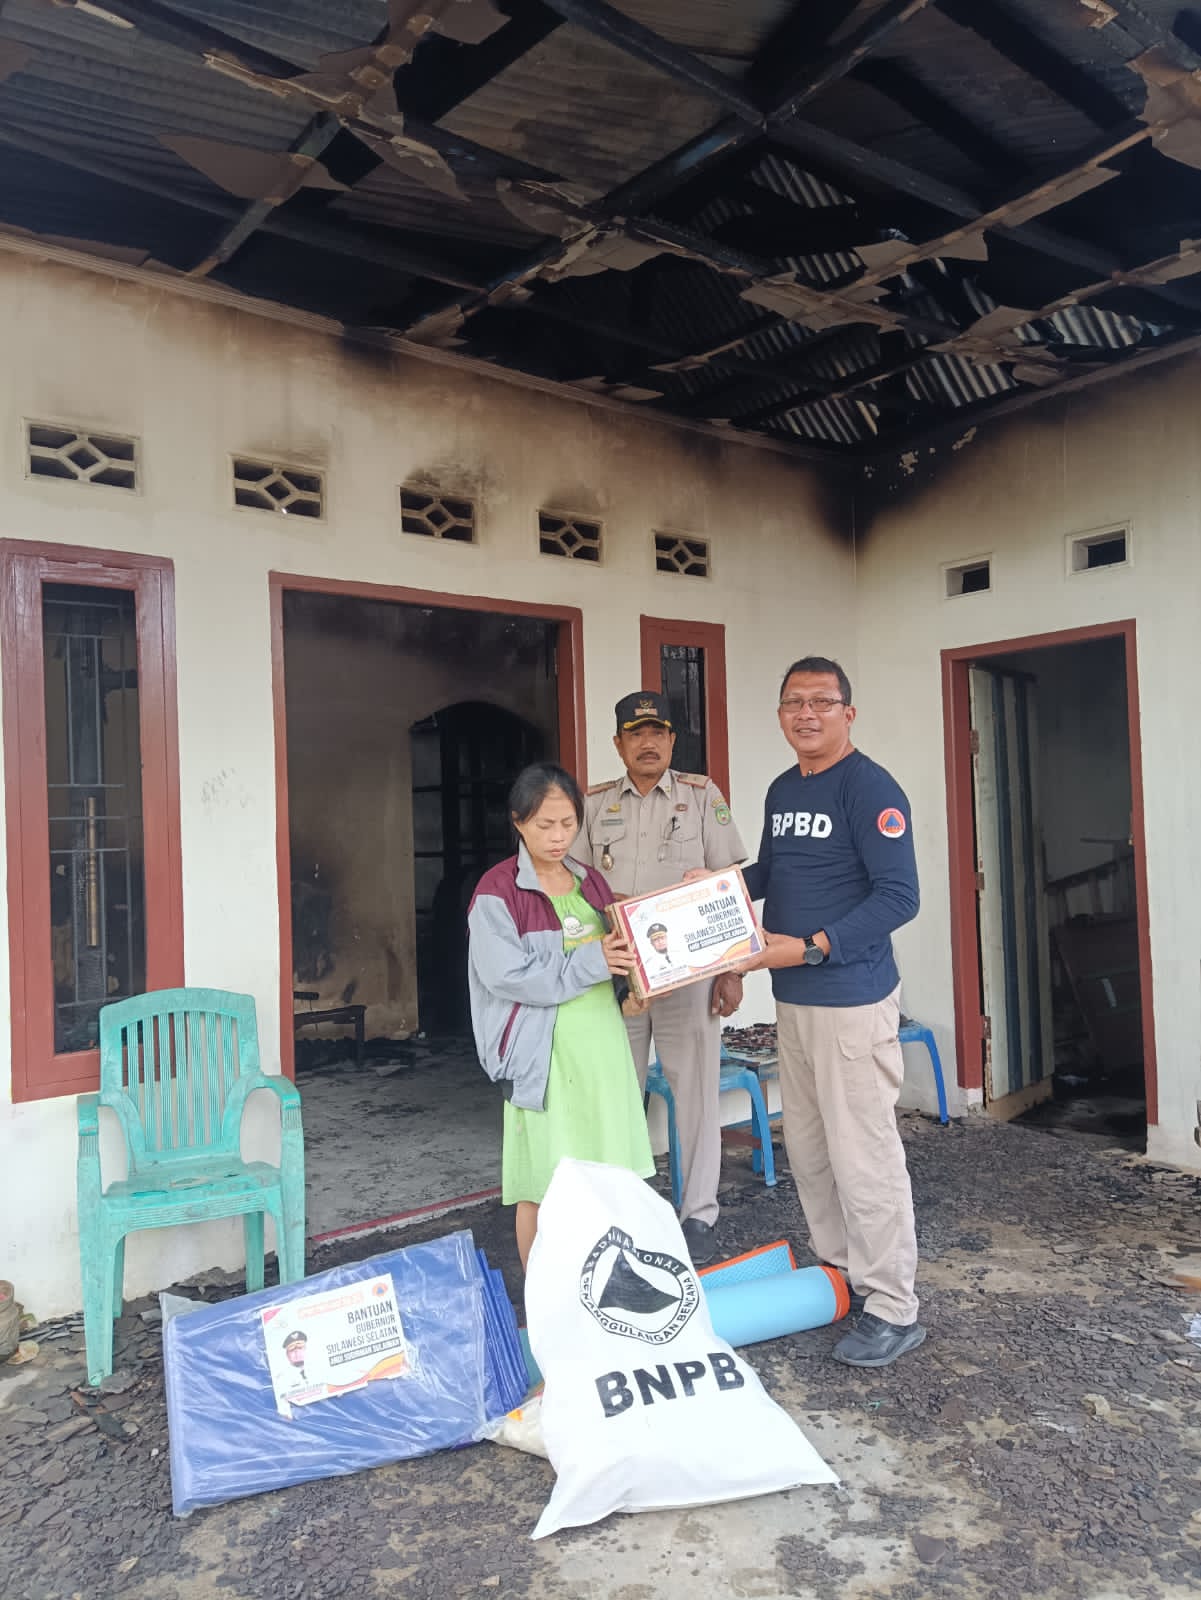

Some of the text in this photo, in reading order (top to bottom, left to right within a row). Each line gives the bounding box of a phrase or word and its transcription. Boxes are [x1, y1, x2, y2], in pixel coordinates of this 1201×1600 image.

[772, 812, 832, 839] BPBD
[698, 895, 737, 916] BANTUAN
[706, 906, 741, 924] GUBERNUR
[684, 925, 716, 943] SULAWESI
[717, 916, 744, 932] SELATAN
[347, 1300, 393, 1324] BANTUAN
[356, 1314, 396, 1334] GUBERNUR
[326, 1335, 365, 1354] SULAWESI
[366, 1325, 398, 1343] SELATAN
[595, 1352, 744, 1418] BNPB
